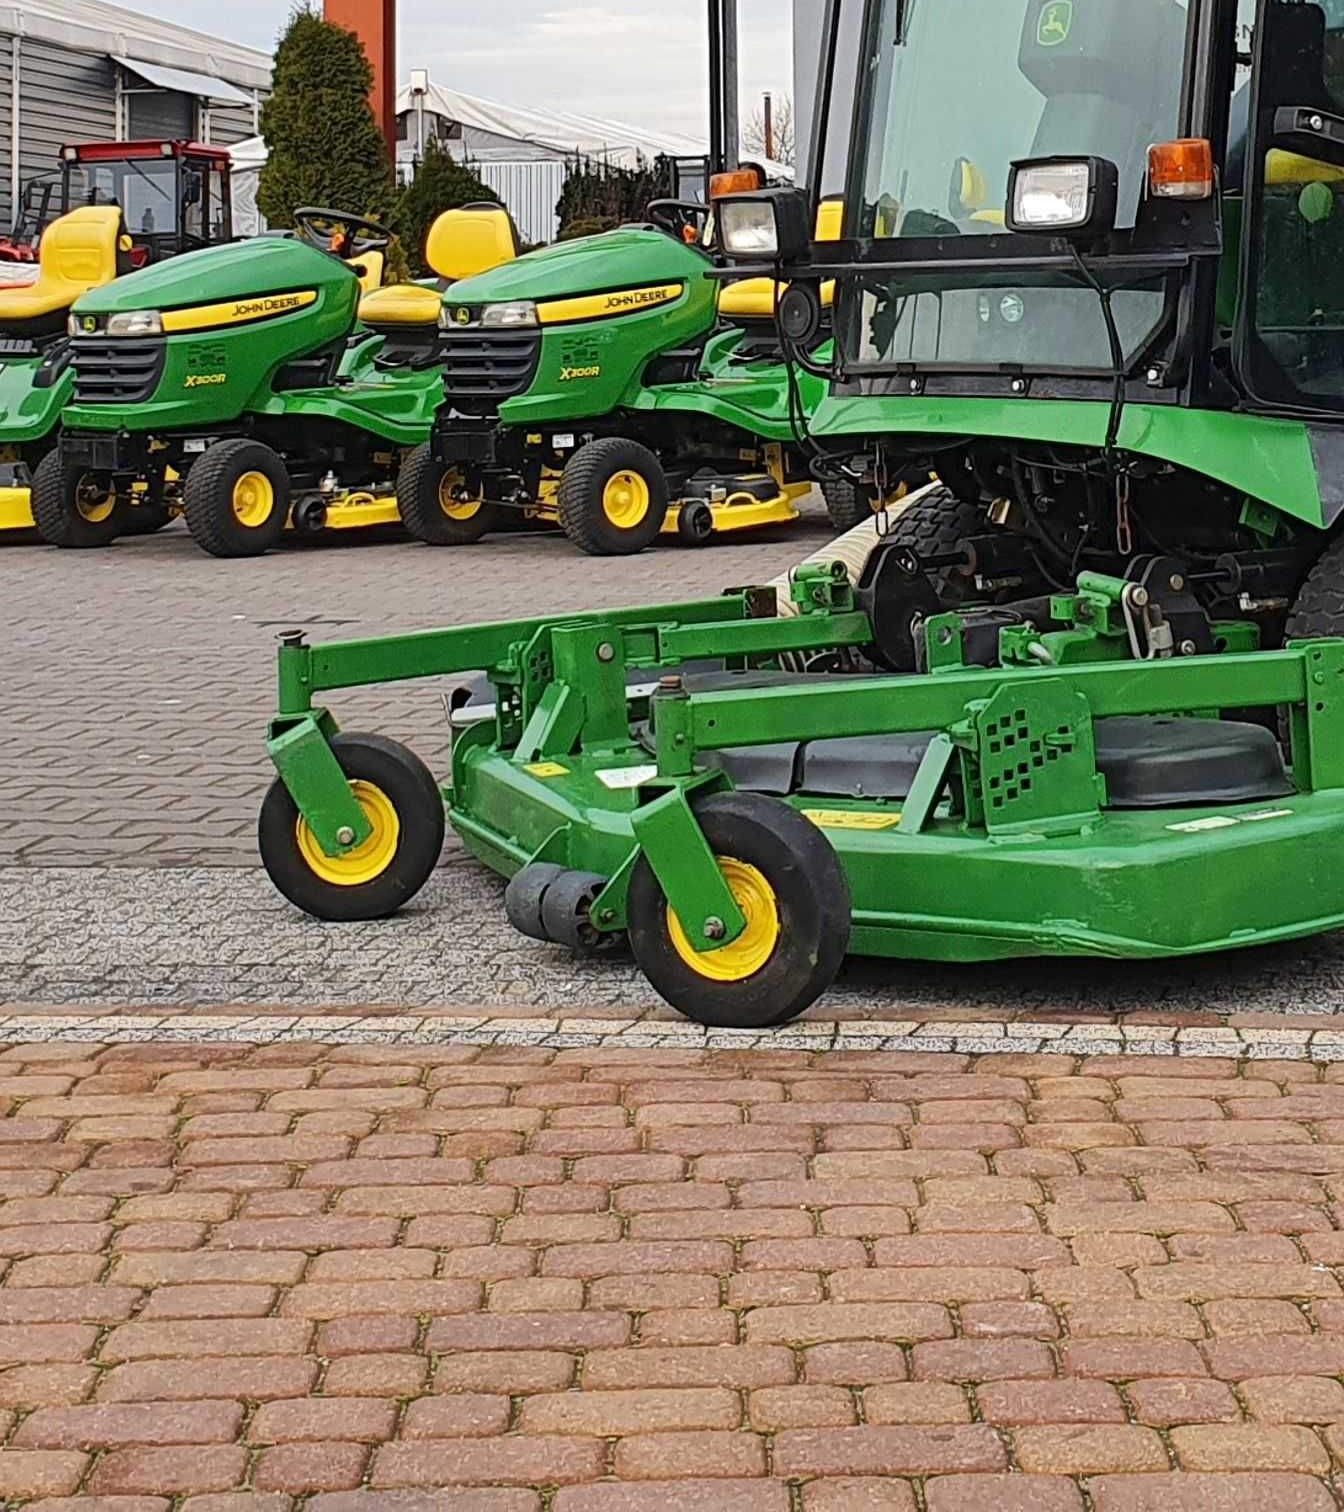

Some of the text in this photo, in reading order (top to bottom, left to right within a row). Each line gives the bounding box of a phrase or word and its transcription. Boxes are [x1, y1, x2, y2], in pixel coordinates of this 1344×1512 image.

[232, 296, 300, 317] JOHN DEERE
[604, 289, 668, 310] JOHN DEERE
